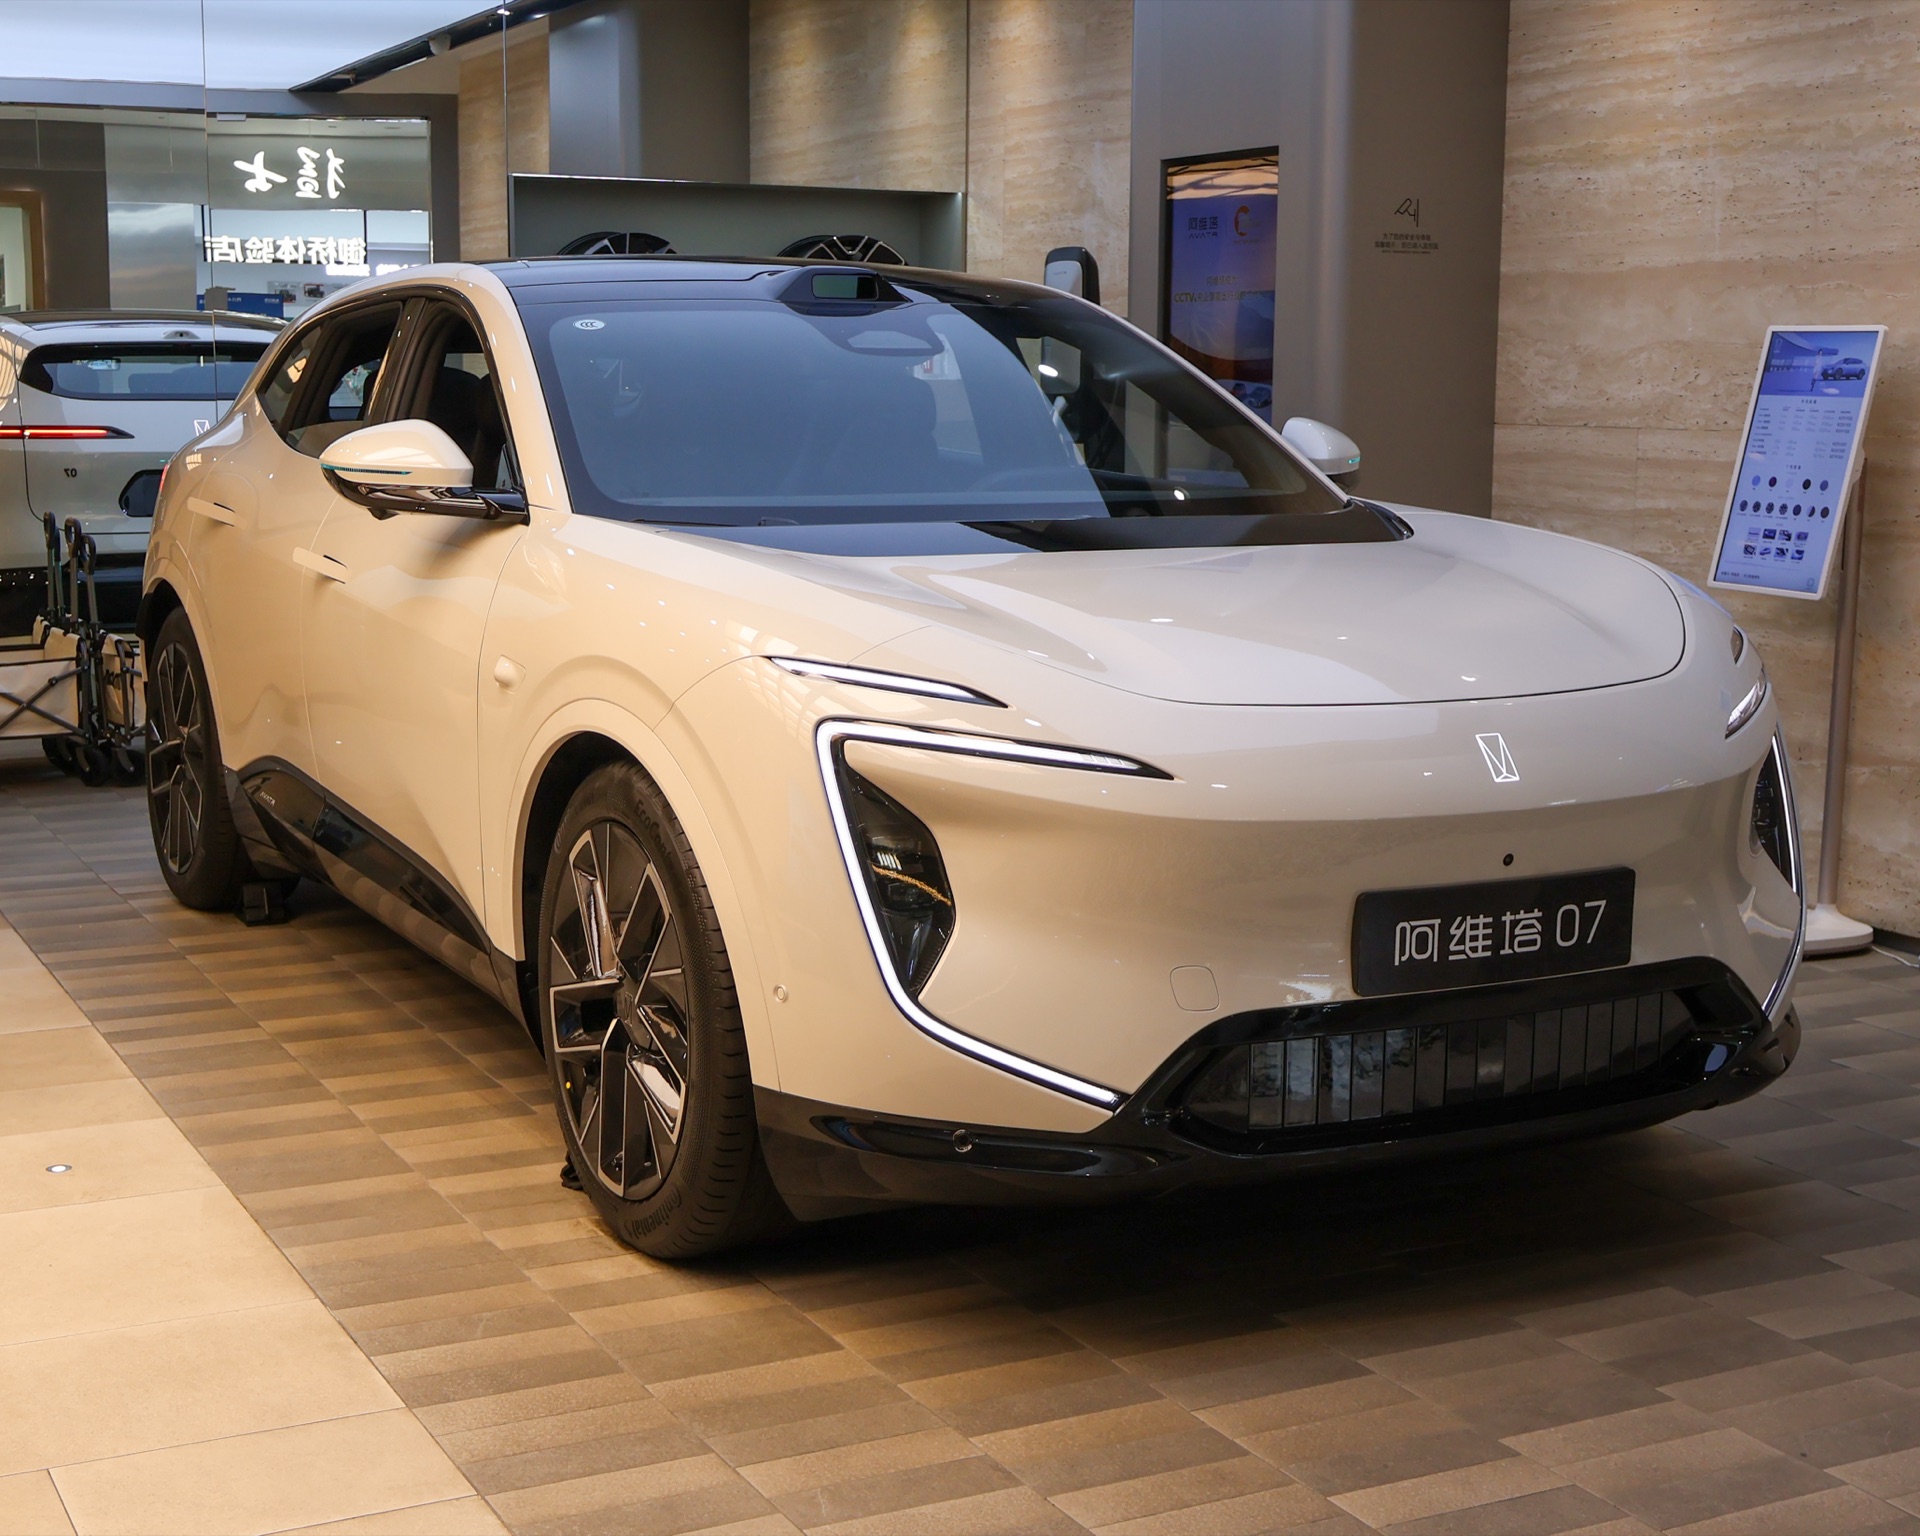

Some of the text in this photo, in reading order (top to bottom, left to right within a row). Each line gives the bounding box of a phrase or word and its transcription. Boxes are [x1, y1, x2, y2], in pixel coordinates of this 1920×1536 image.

[1189, 216, 1218, 231] 阿维塔
[1394, 899, 1607, 966] 阿维塔 07
